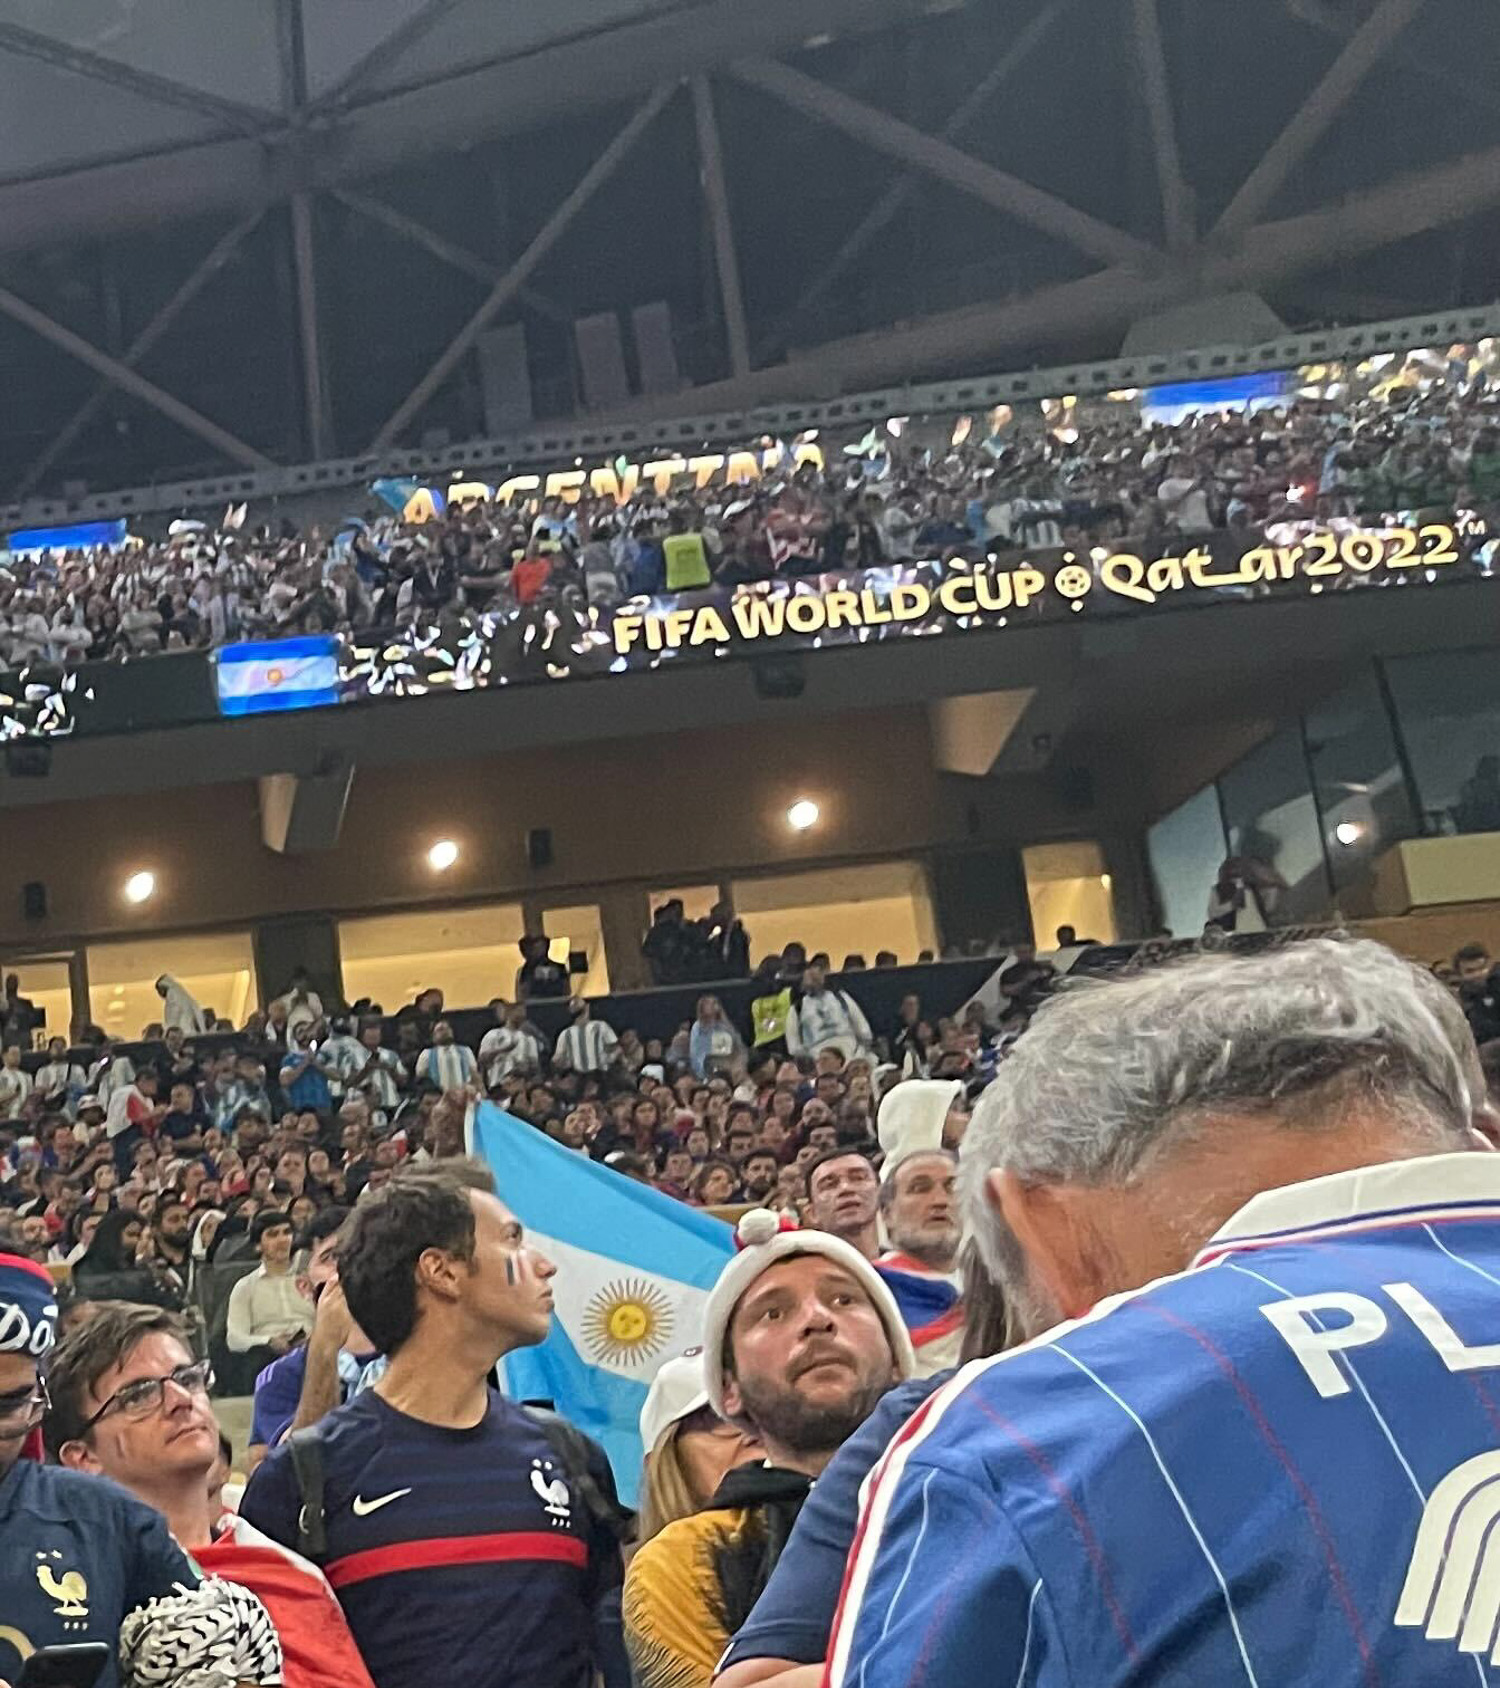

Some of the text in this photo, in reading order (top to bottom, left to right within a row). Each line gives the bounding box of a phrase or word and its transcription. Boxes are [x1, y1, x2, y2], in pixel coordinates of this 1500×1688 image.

[613, 605, 731, 654] FIFA
[732, 583, 931, 640] WORLD
[940, 569, 1046, 615] CUP
